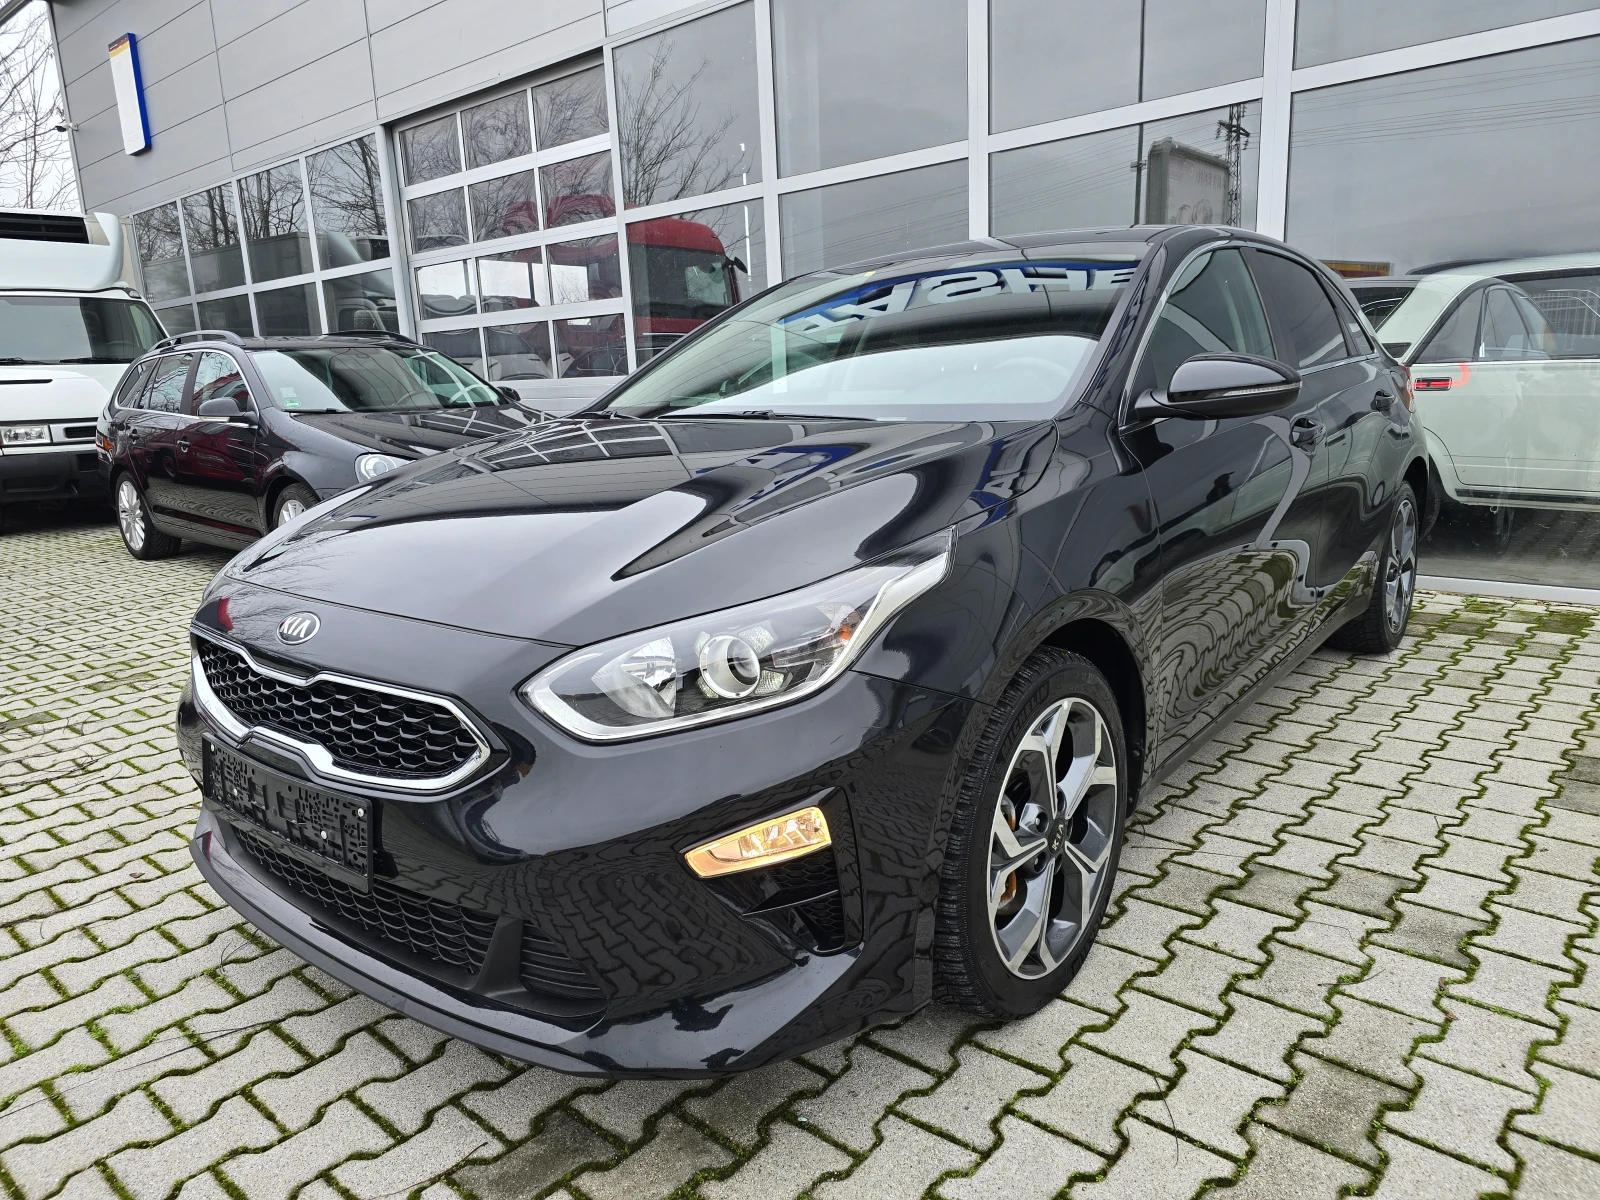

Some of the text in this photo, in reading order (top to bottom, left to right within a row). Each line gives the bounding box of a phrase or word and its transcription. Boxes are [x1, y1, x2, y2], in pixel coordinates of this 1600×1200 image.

[279, 616, 312, 639] KIA
[1001, 683, 1048, 760] MICHELIN
[1051, 823, 1064, 851] KIA
